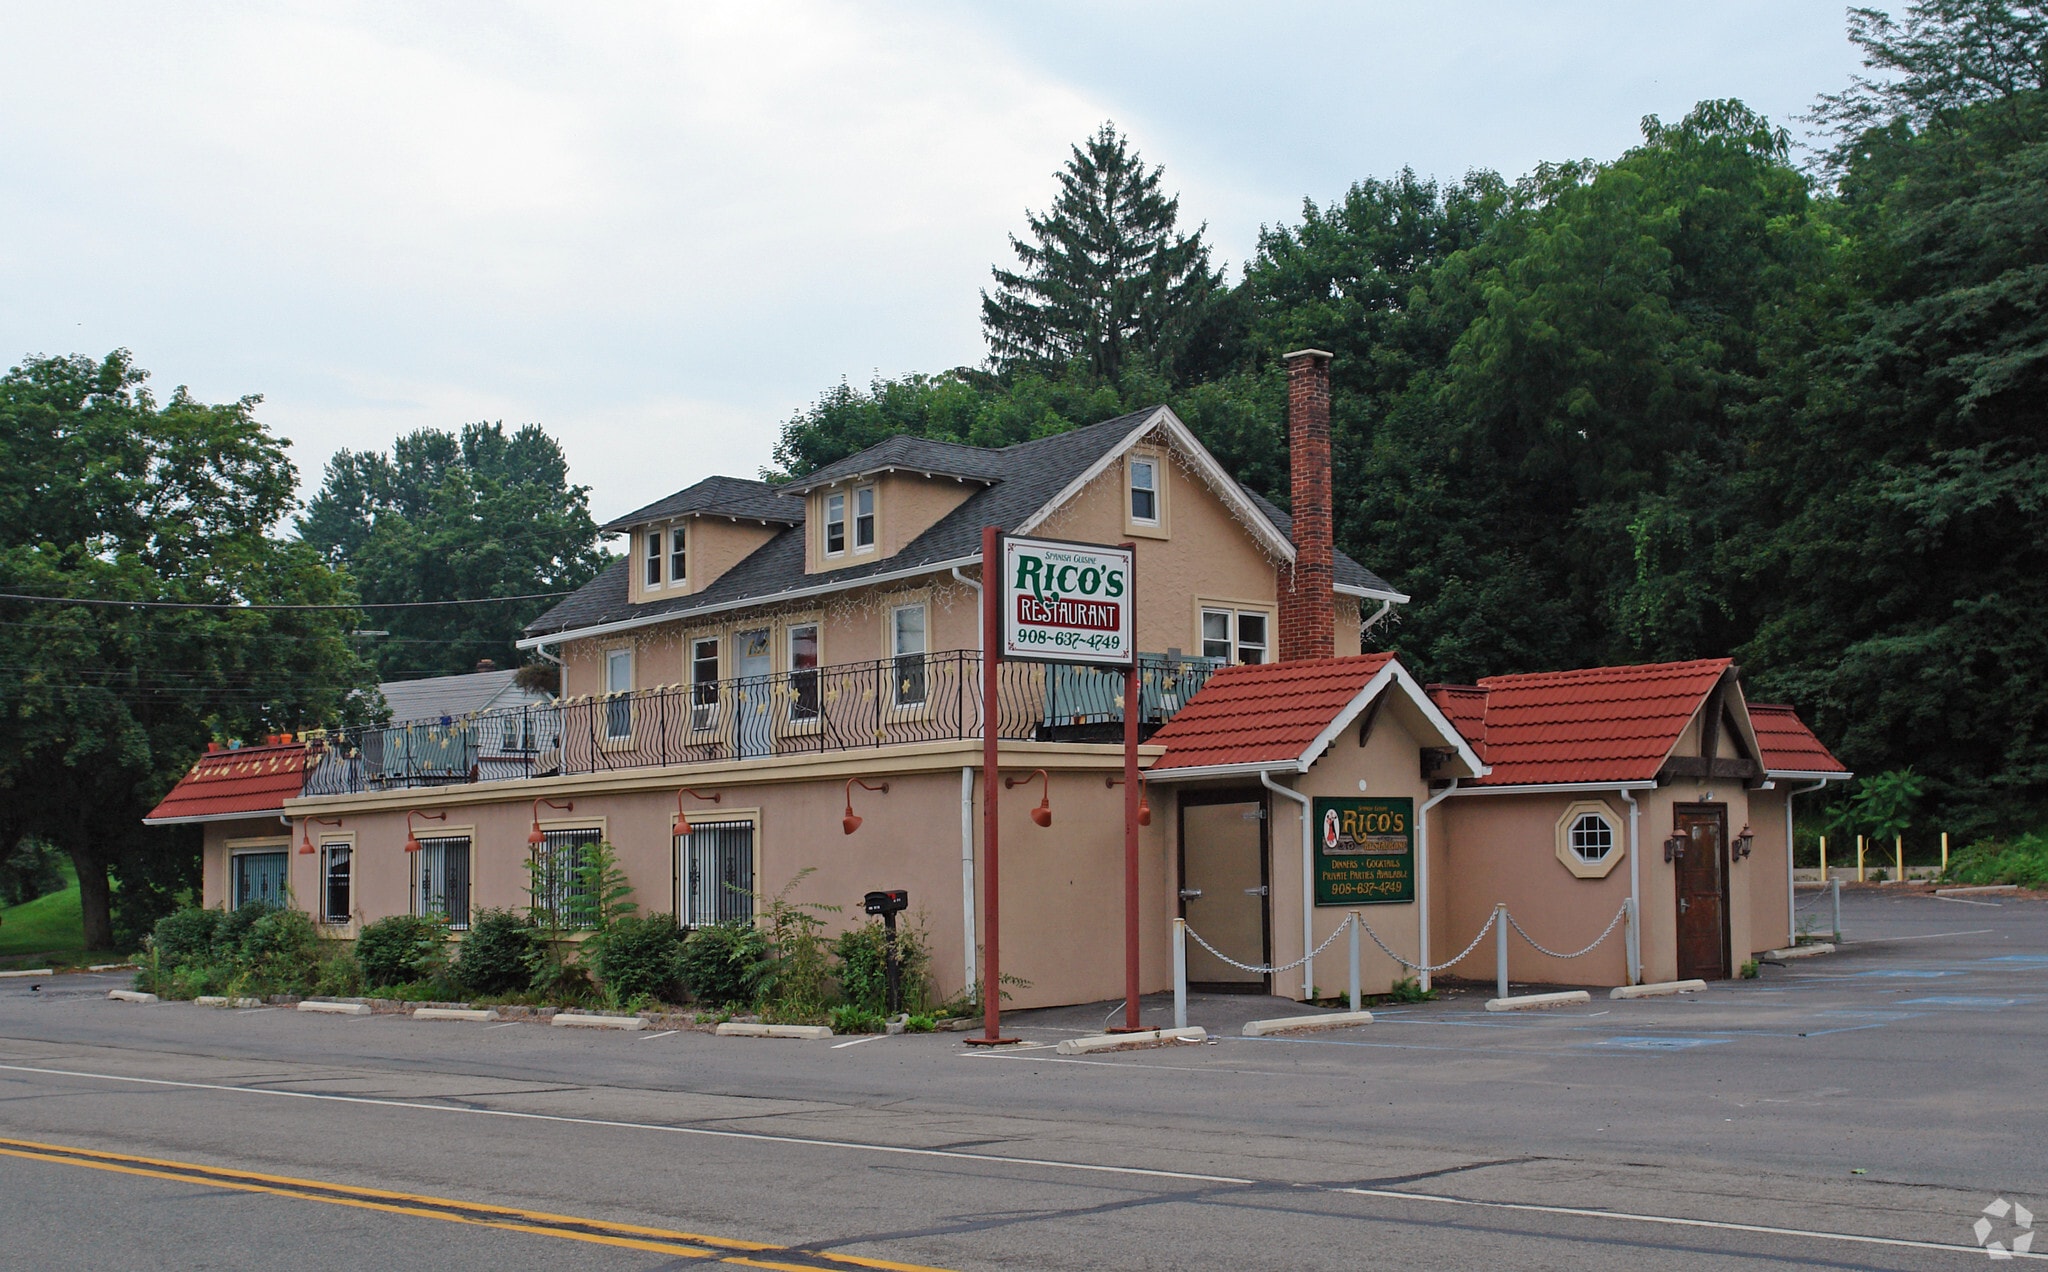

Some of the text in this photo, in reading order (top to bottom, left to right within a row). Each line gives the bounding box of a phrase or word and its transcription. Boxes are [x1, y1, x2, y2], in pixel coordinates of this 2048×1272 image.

[1045, 551, 1096, 564] SPANISH CUISINE
[1014, 555, 1124, 608] RICO'S
[1021, 599, 1116, 627] RESTAURANT
[1342, 810, 1404, 844] RICO'S
[1331, 859, 1400, 869] DINNERS COCKTAILS
[1322, 869, 1408, 880] PRIVATE PARTIES AVAILABLE
